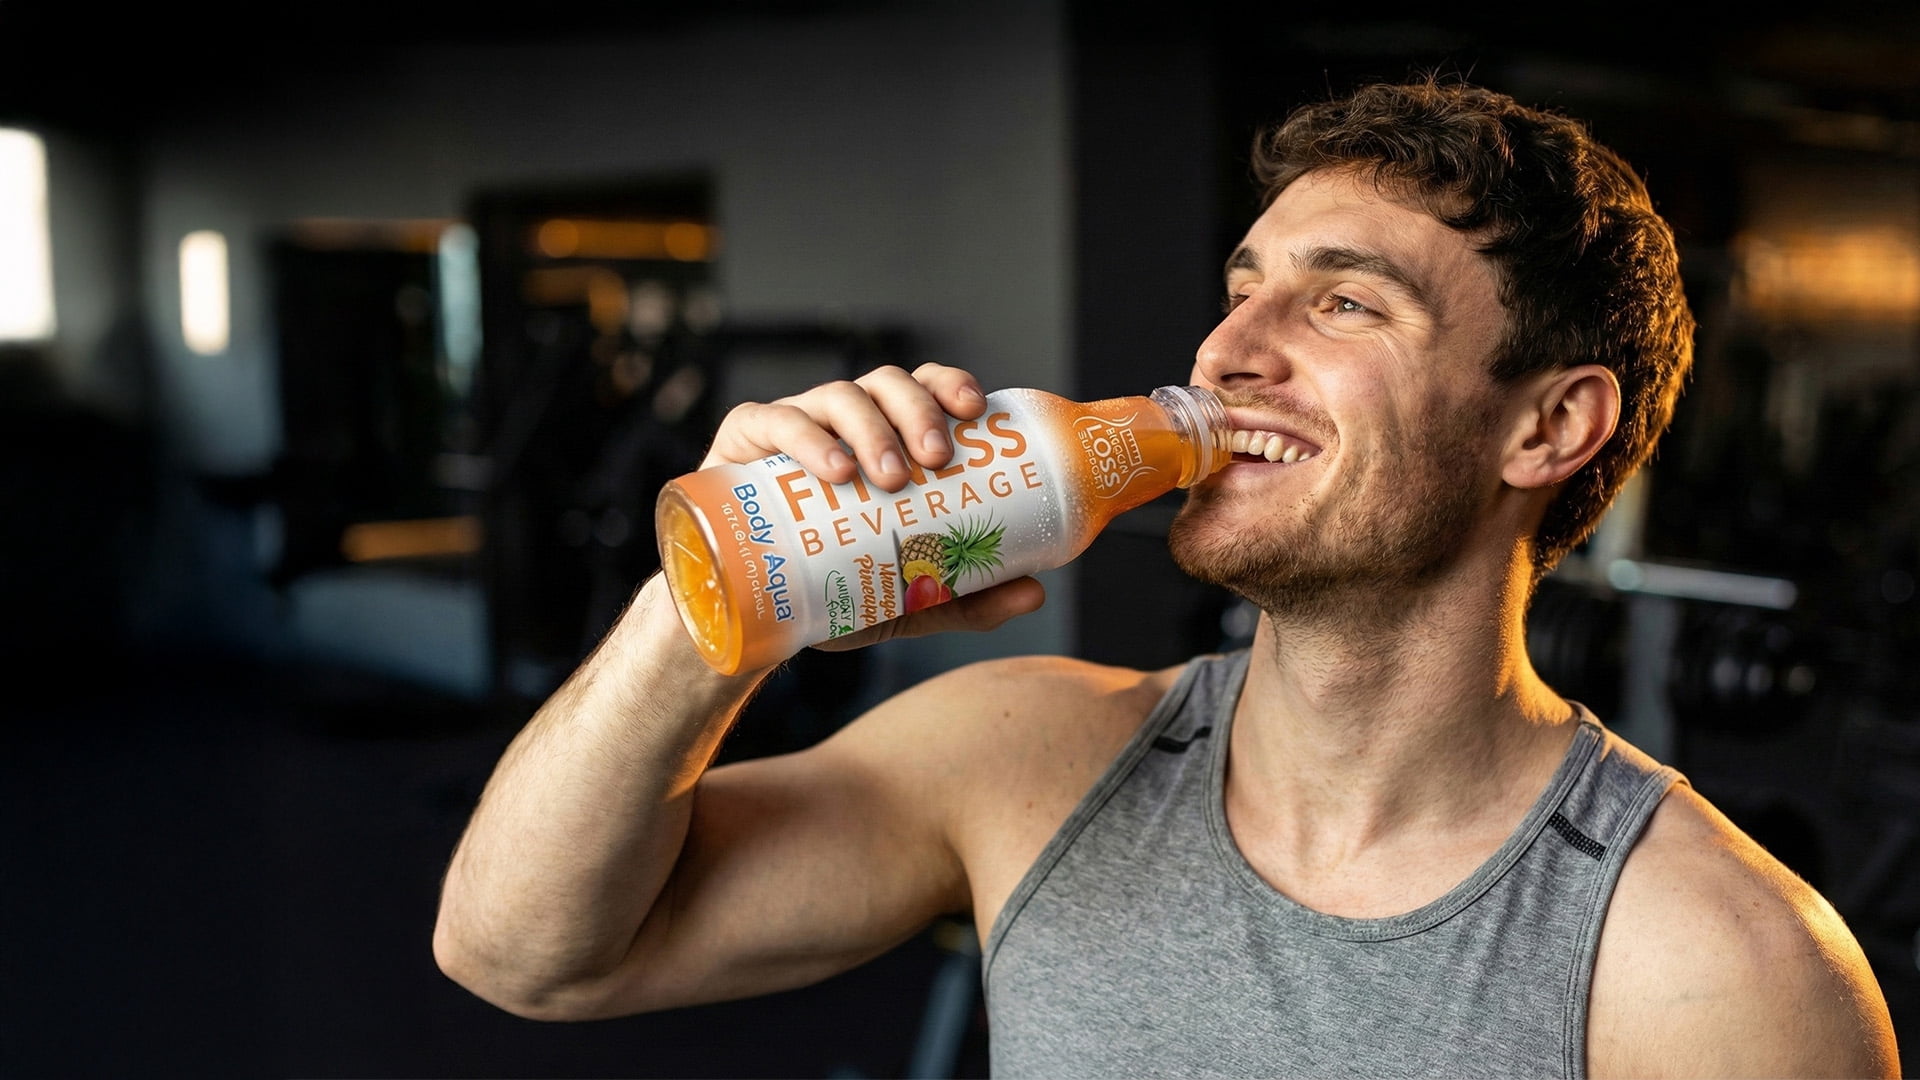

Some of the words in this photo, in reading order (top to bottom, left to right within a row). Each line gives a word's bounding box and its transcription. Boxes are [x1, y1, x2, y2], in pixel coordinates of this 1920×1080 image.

[1086, 424, 1120, 487] LOSS
[800, 462, 1043, 556] BEVERAGE
[734, 483, 775, 544] Body
[763, 554, 795, 621] Aqua
[853, 554, 877, 627] Pineapp
